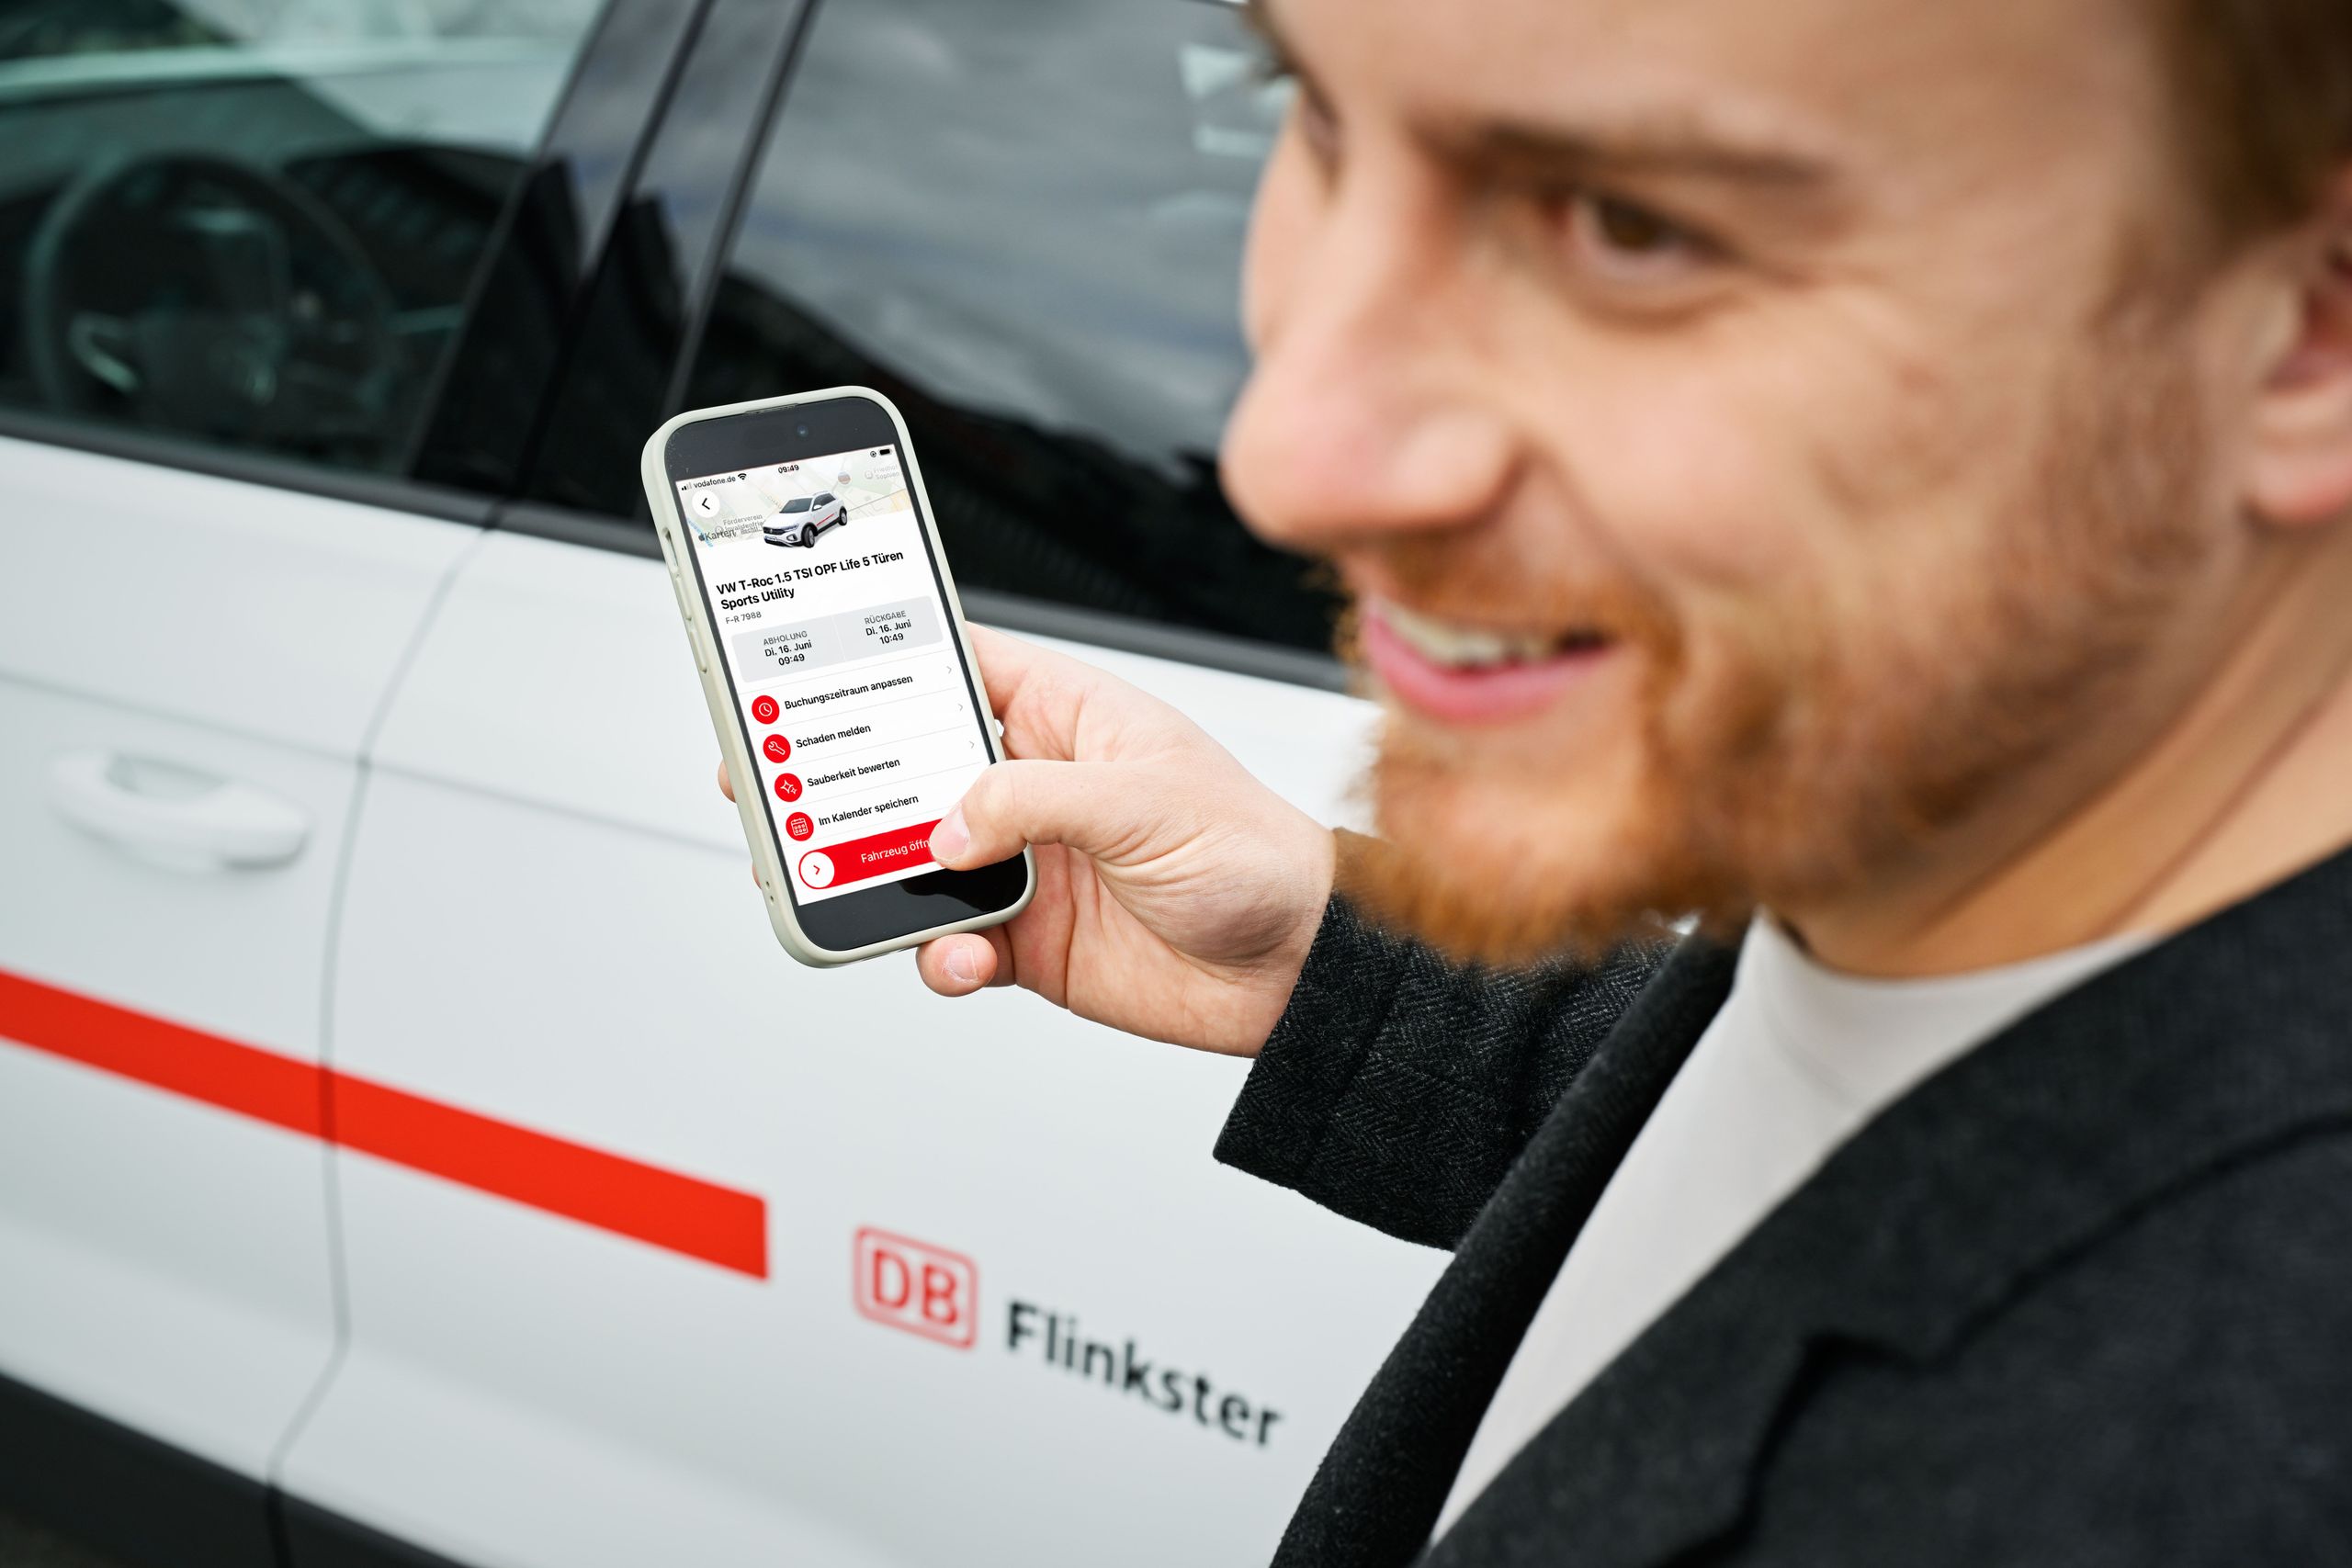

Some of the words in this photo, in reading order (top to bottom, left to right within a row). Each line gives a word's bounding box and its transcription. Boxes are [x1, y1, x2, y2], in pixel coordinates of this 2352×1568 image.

[778, 464, 799, 474] 09:49
[694, 476, 736, 489] vodafone.de
[705, 528, 735, 541] Karten
[717, 581, 737, 595] VW
[739, 575, 774, 592] T-Roc
[775, 571, 792, 584] 1.5
[794, 567, 813, 581] TSI
[815, 562, 838, 576] OPF
[840, 558, 860, 571] Life
[863, 556, 870, 567] 5
[871, 551, 904, 565] Türen
[720, 594, 760, 611] Sports
[761, 587, 795, 603] Utility
[725, 615, 739, 625] F-R
[741, 611, 762, 622] 7988
[864, 609, 907, 625] RÜCKGABE
[865, 626, 878, 637] Di.
[879, 623, 893, 634] 16.
[894, 618, 911, 631] Juni
[763, 630, 808, 646] ABHOLUNG
[879, 632, 904, 645] 10:49
[764, 648, 777, 658] Di.
[778, 645, 792, 655] 16.
[794, 639, 812, 651] Juni
[778, 653, 805, 666] 09:49
[784, 684, 869, 710] Buchungszeitraum
[870, 673, 913, 691] anpassen
[796, 732, 836, 749] Schaden
[838, 723, 871, 739] melden
[807, 768, 856, 787] Sauberkeit
[857, 758, 900, 775] bewerten
[818, 816, 831, 827] Im
[832, 806, 873, 823] Kalender
[875, 795, 919, 815] speichern
[861, 843, 909, 863] Fahrzeug
[910, 838, 931, 852] öffn
[870, 1247, 958, 1327] DB
[1007, 1299, 1285, 1449] Flinkster
